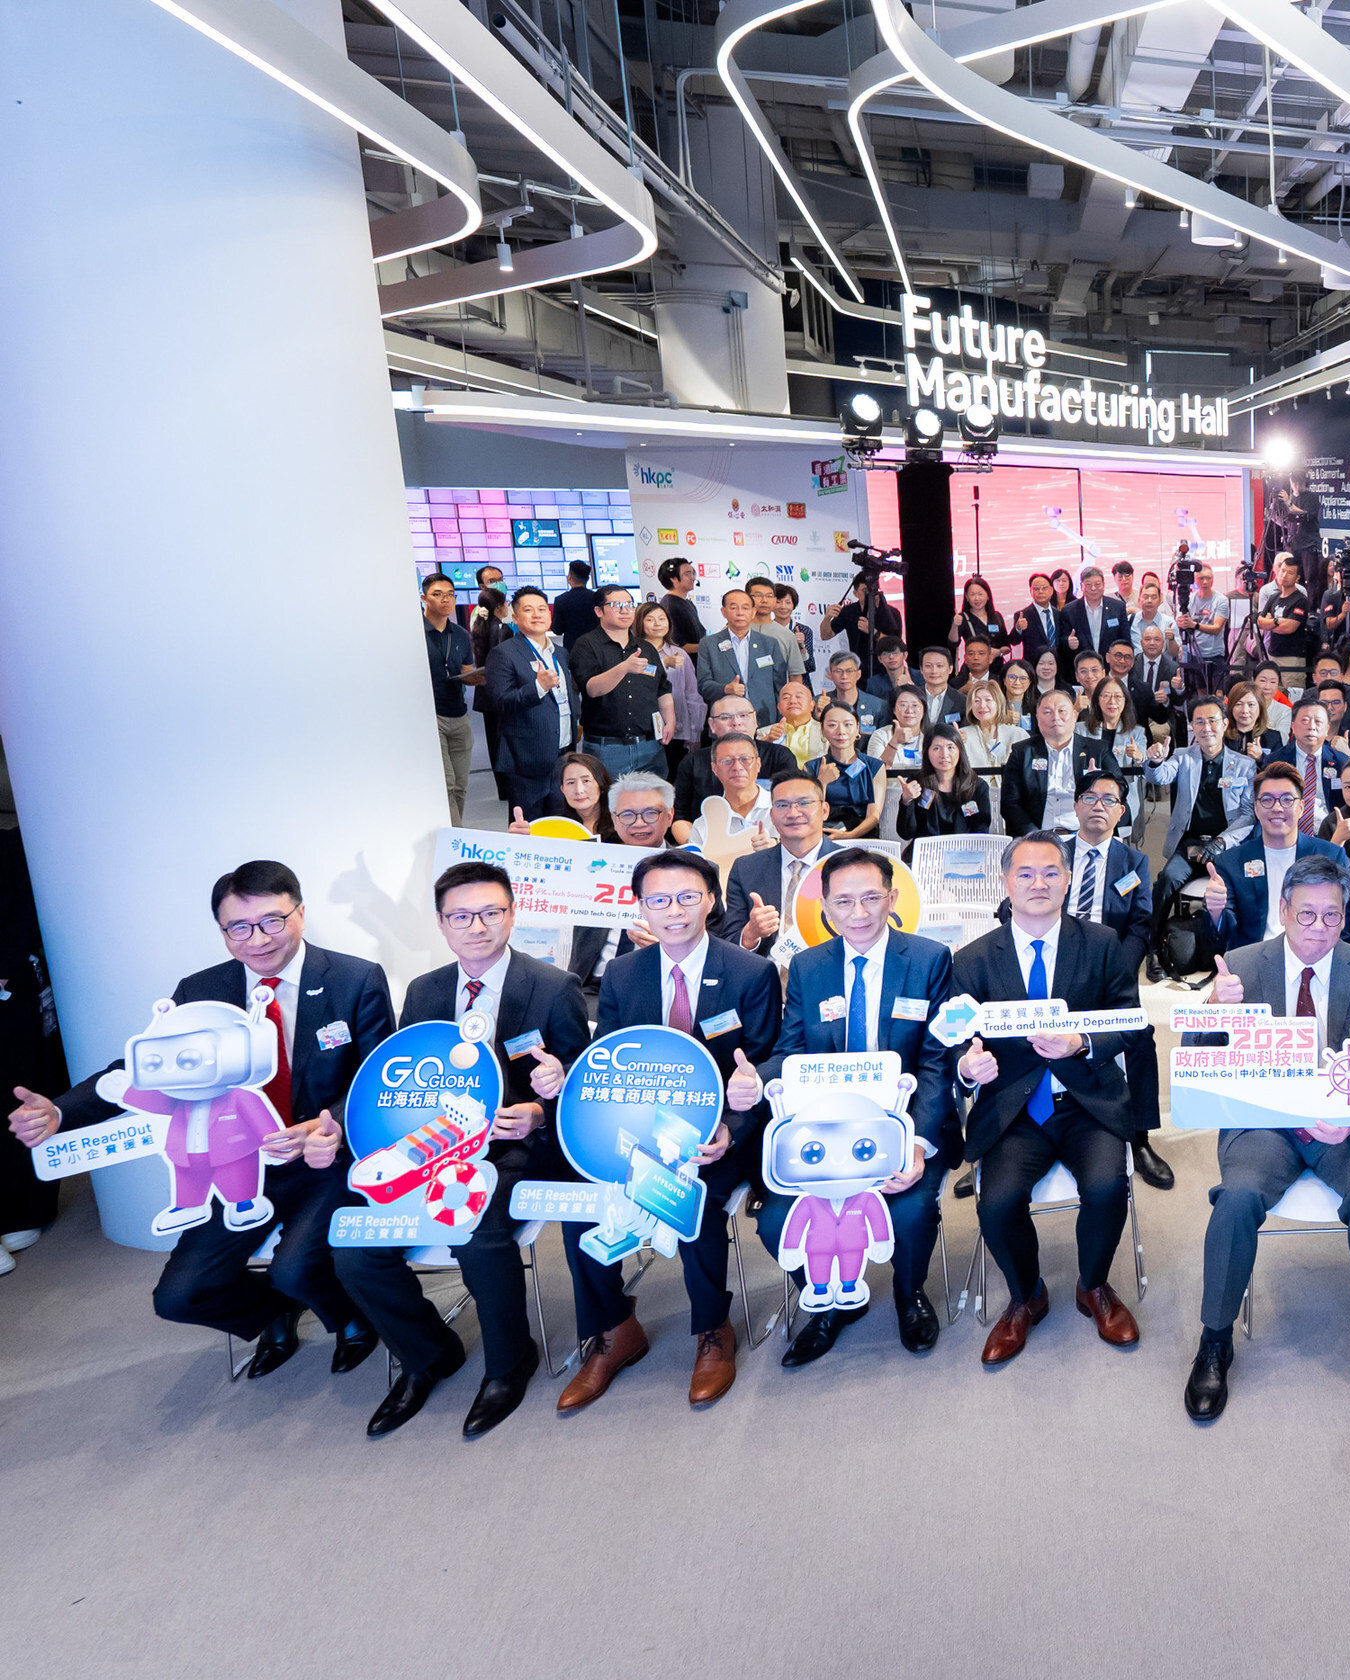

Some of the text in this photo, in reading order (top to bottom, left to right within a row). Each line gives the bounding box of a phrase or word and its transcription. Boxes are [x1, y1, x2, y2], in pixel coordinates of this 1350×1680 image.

[900, 293, 1046, 367] Future
[905, 353, 1229, 443] Manufacturing Hall
[641, 467, 672, 488] hkpc
[771, 535, 798, 545] CATALO
[1321, 537, 1328, 558] 6
[776, 565, 794, 574] SW
[461, 842, 506, 862] hkpc
[514, 852, 573, 865] SME ReachOut
[784, 938, 802, 954] SME
[984, 1006, 1060, 1019] 工業貿易署
[984, 1015, 1143, 1031] Trade and Industry Department
[1174, 1016, 1218, 1028] FUND
[1220, 1016, 1257, 1028] FAIR
[1288, 1019, 1315, 1027] Sourcing
[1233, 1029, 1314, 1049] 2025
[587, 1043, 694, 1073] eCommerce
[1176, 1050, 1314, 1068] 政府資助與科技博覽
[800, 1061, 883, 1074] SME ReachOut
[1174, 1068, 1314, 1078] FUND Tech Go 中小企「智」創未來
[429, 1075, 481, 1088] GLOBAL
[583, 1072, 686, 1088] LIVE & RetailTech
[377, 1091, 439, 1108] 出海拓展
[580, 1086, 717, 1107] 跨境電商與零售科技
[46, 1123, 152, 1157] SME ReachOut
[653, 1173, 686, 1199] APPROVED
[519, 1188, 598, 1202] SME ReachOut
[338, 1214, 419, 1227] SME ReachOut
